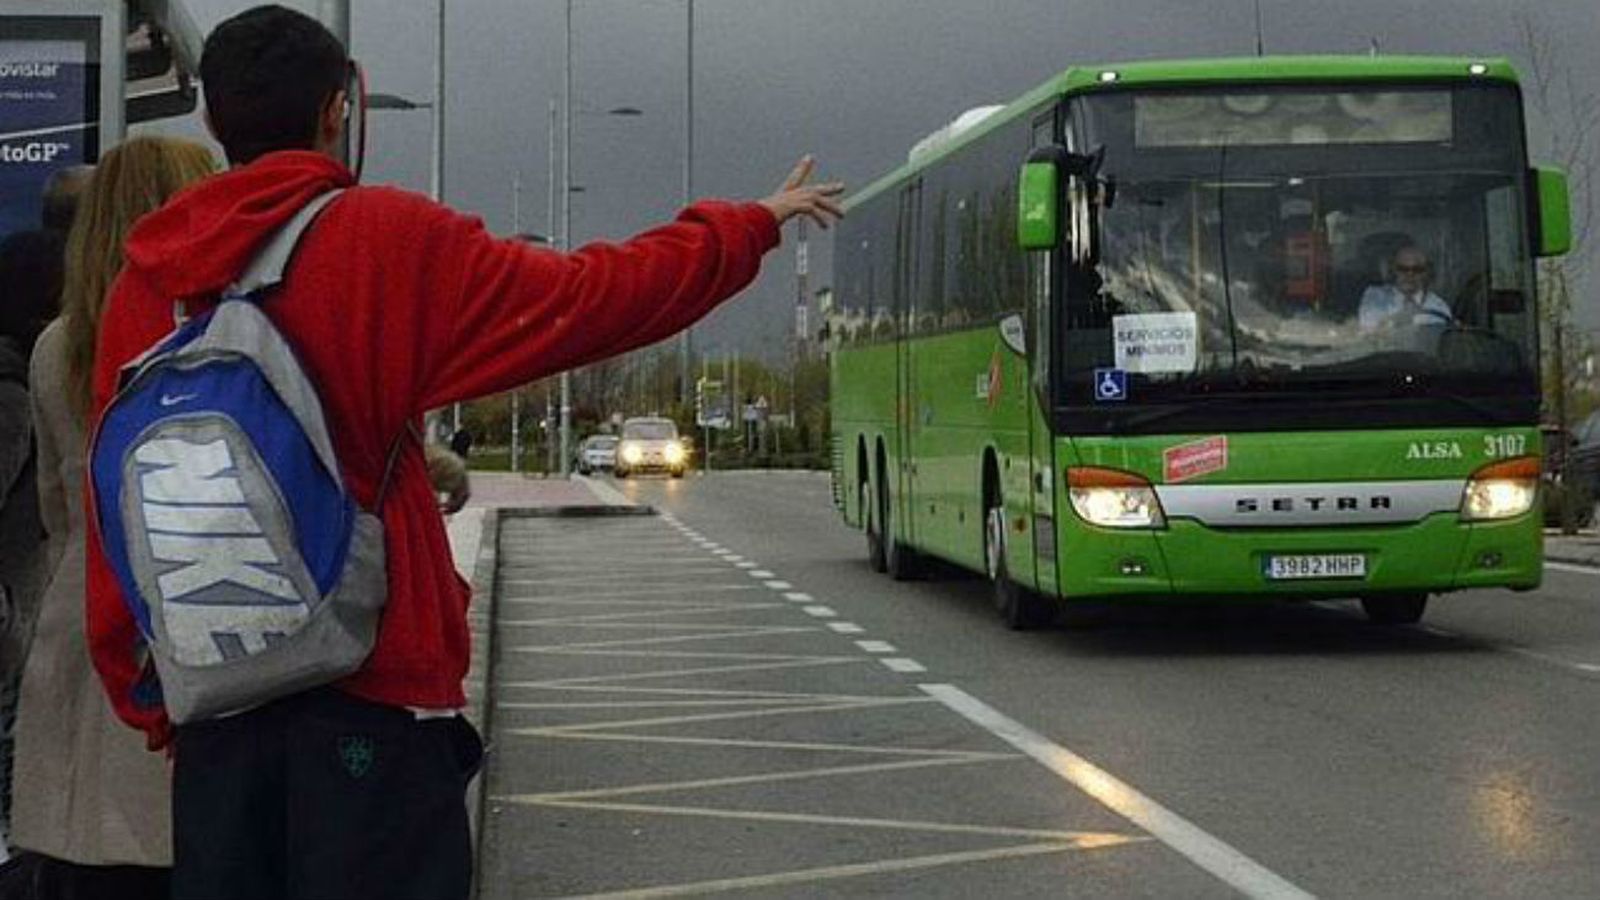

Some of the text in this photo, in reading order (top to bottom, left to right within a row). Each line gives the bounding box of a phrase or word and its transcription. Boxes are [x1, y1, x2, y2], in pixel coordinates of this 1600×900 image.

[1405, 441, 1462, 459] ALSA
[1483, 434, 1527, 456] 3107
[1236, 496, 1390, 512] SETRA
[134, 438, 310, 666] NIKE
